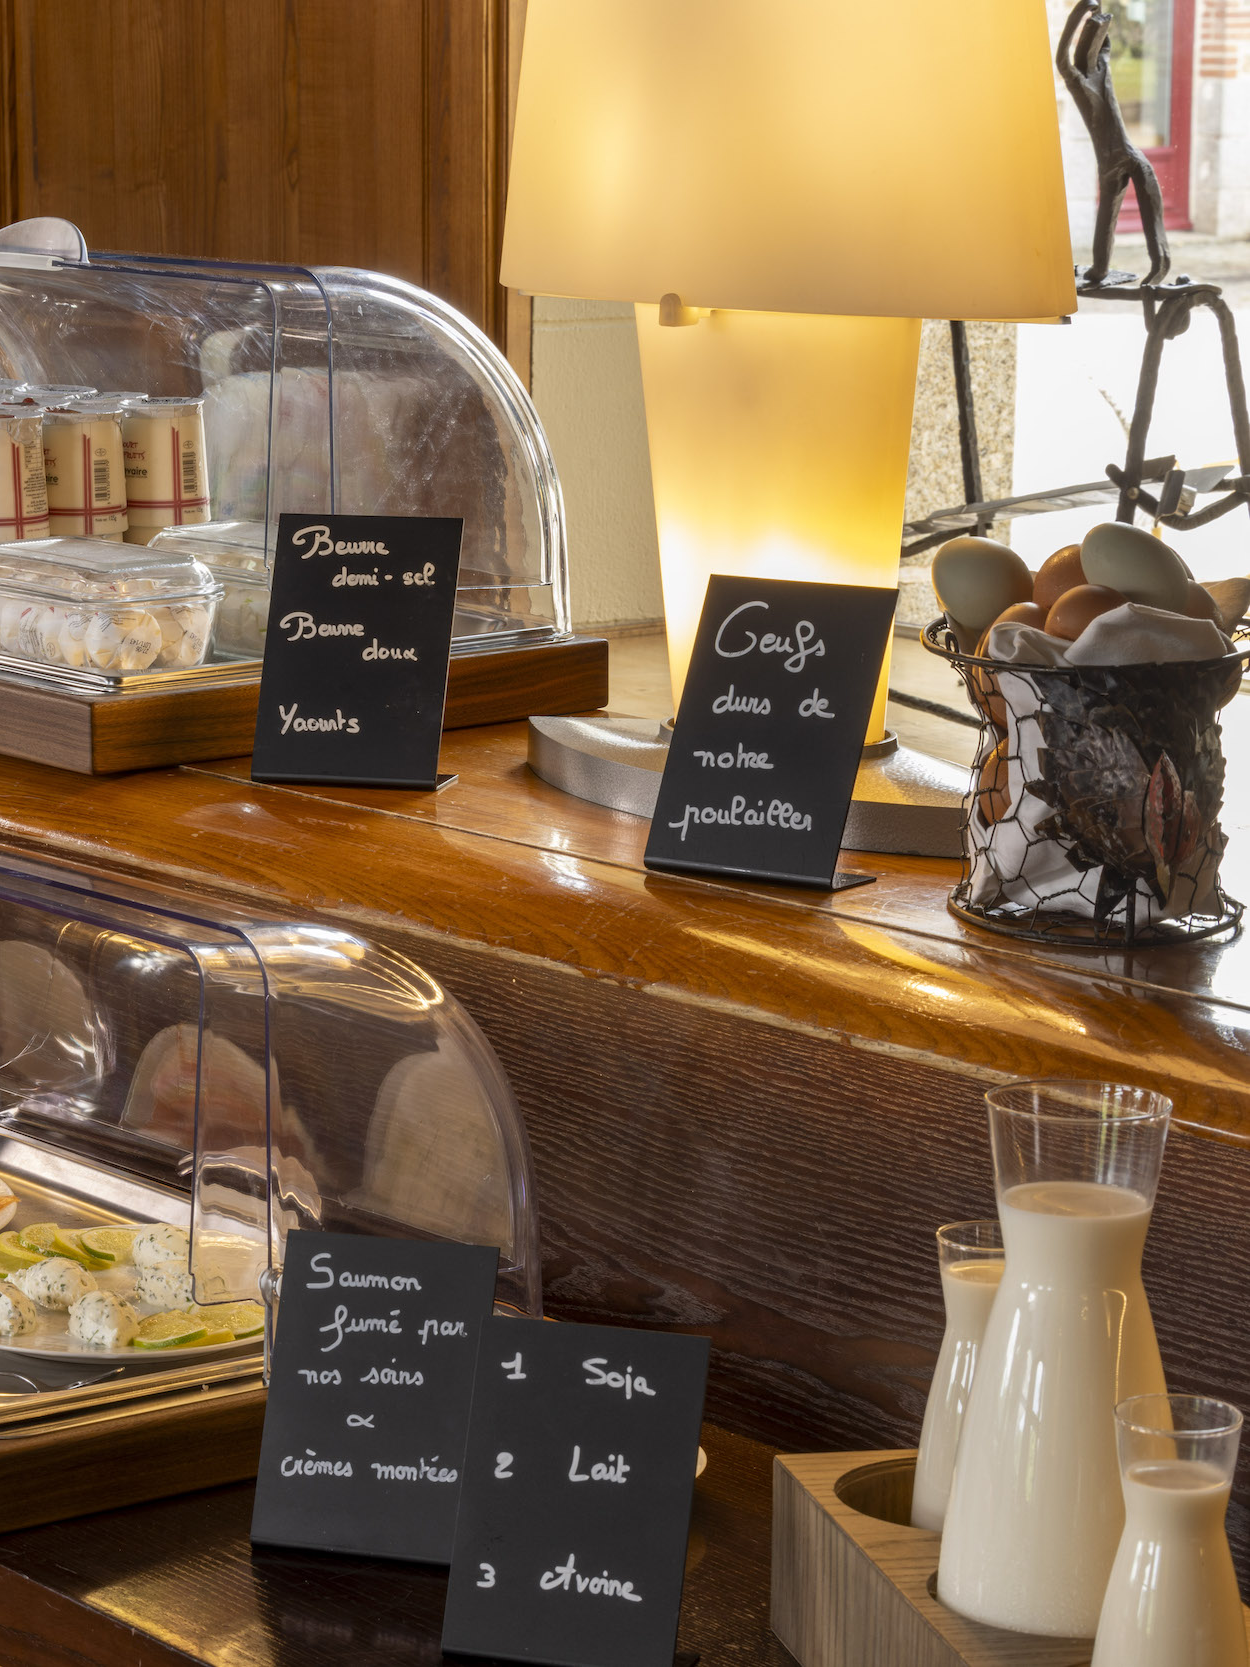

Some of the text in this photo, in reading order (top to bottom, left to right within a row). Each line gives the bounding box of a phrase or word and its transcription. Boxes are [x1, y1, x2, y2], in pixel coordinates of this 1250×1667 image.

[292, 525, 390, 560] Beurre
[279, 611, 365, 642] Beurre
[361, 638, 418, 661] doux
[278, 703, 360, 735] Yaourts
[711, 684, 836, 719] durs de
[692, 742, 775, 769] notre
[668, 795, 813, 842] poulailler
[305, 1252, 423, 1292] Saumon
[319, 1304, 468, 1353] fumé par
[297, 1357, 425, 1387] nos soins
[500, 1351, 657, 1400] 1 Soja
[370, 1455, 459, 1483] montées
[494, 1445, 631, 1484] 2 Lait
[476, 1553, 643, 1602] 3 Avoine
